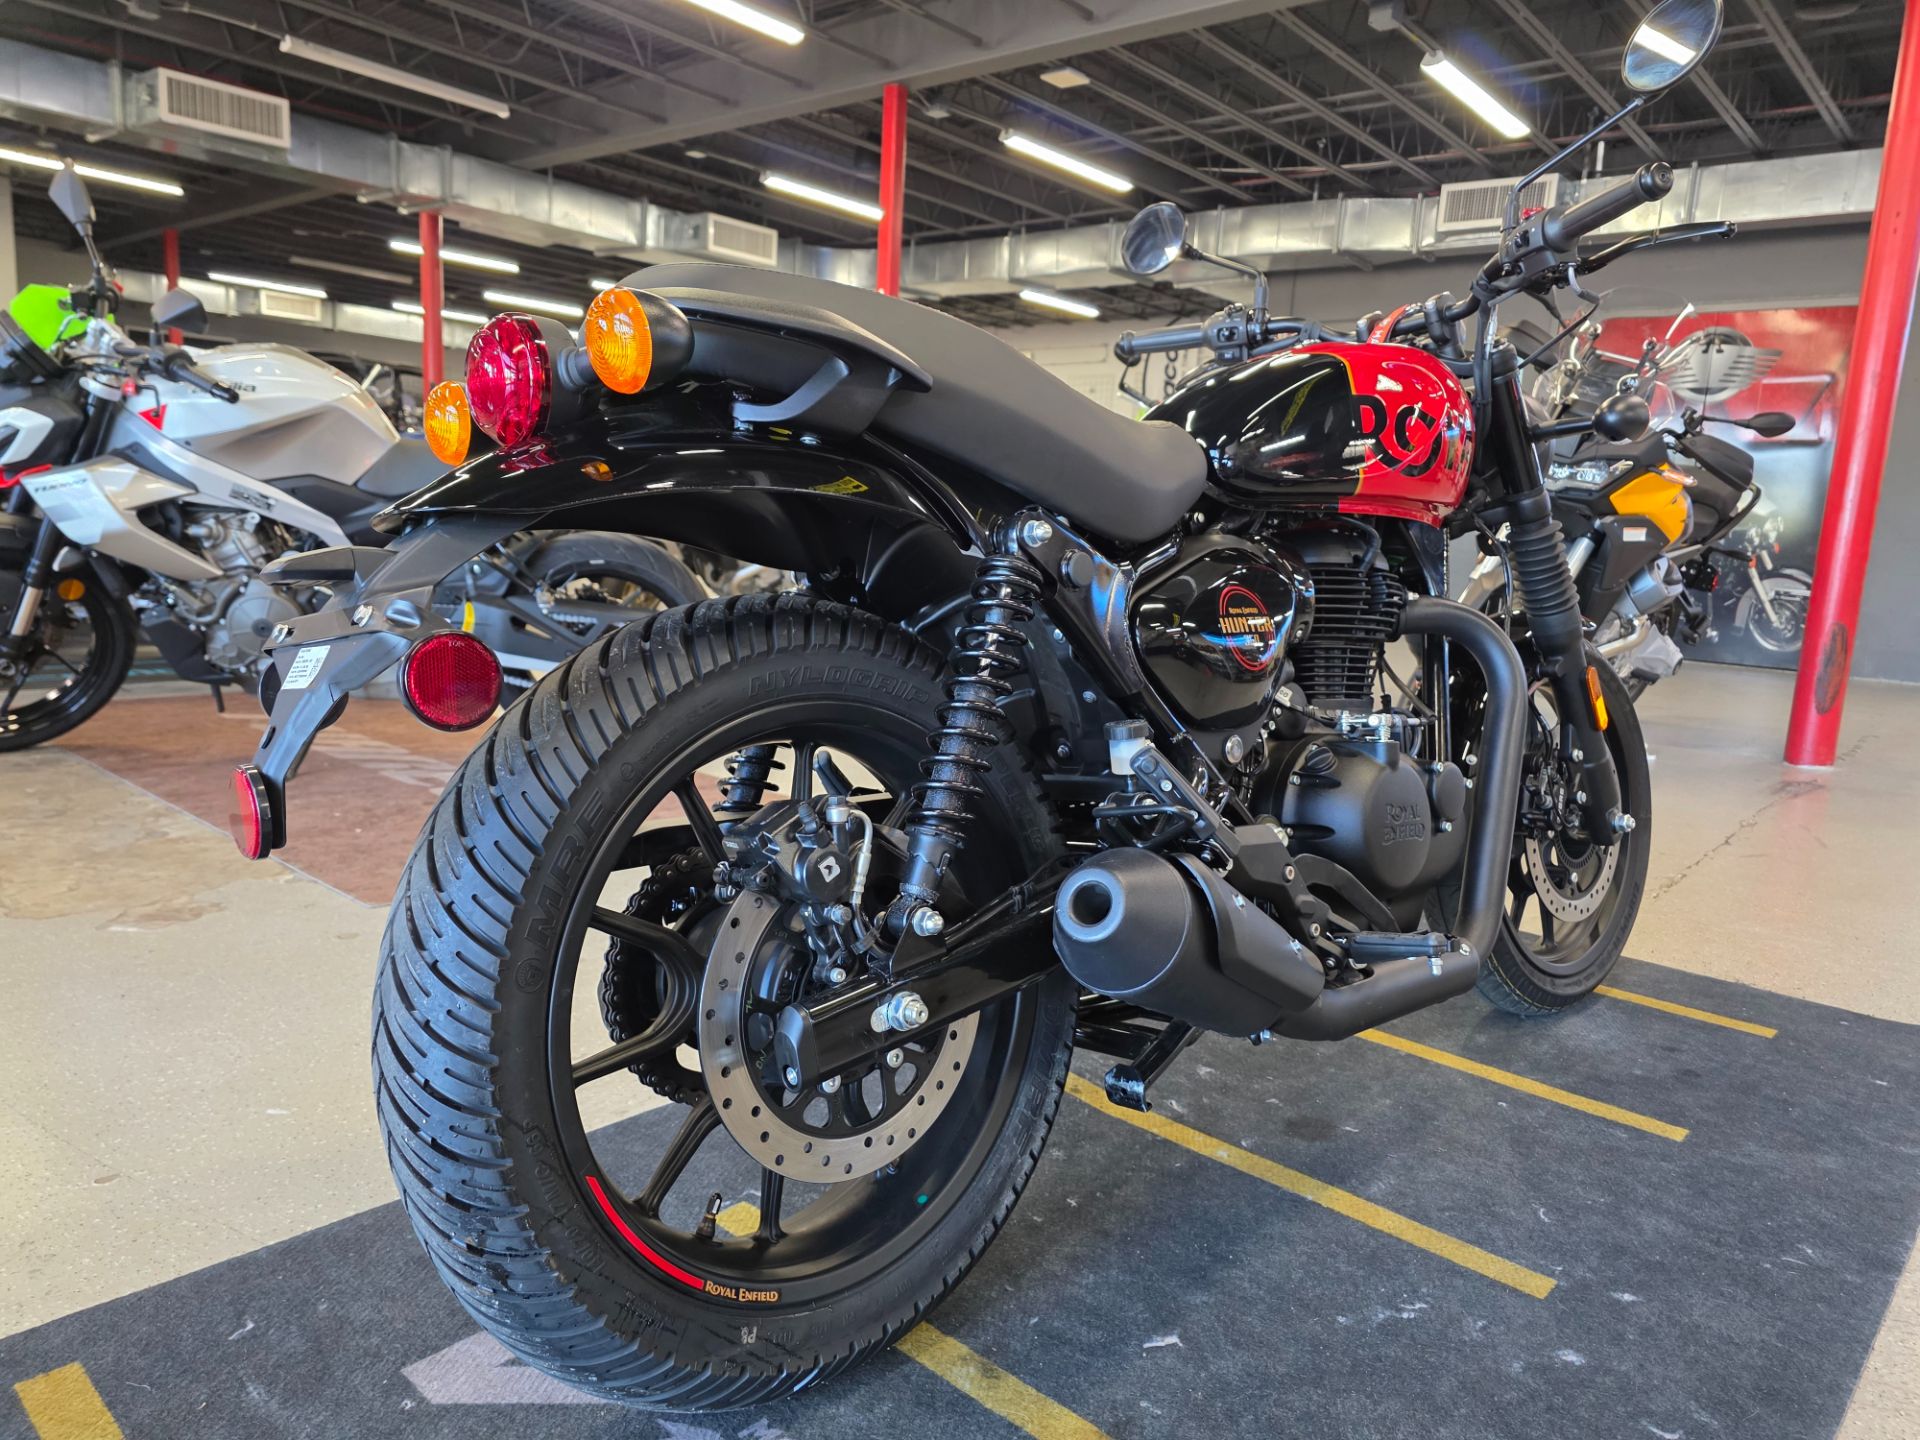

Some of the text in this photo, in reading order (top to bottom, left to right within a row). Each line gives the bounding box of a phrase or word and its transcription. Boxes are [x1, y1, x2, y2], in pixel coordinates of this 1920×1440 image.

[1220, 616, 1273, 634] HUNTER
[750, 664, 929, 705] NYLOGRIP
[524, 788, 606, 950] MRF
[705, 1280, 778, 1302] ROYAL ENFIELD
